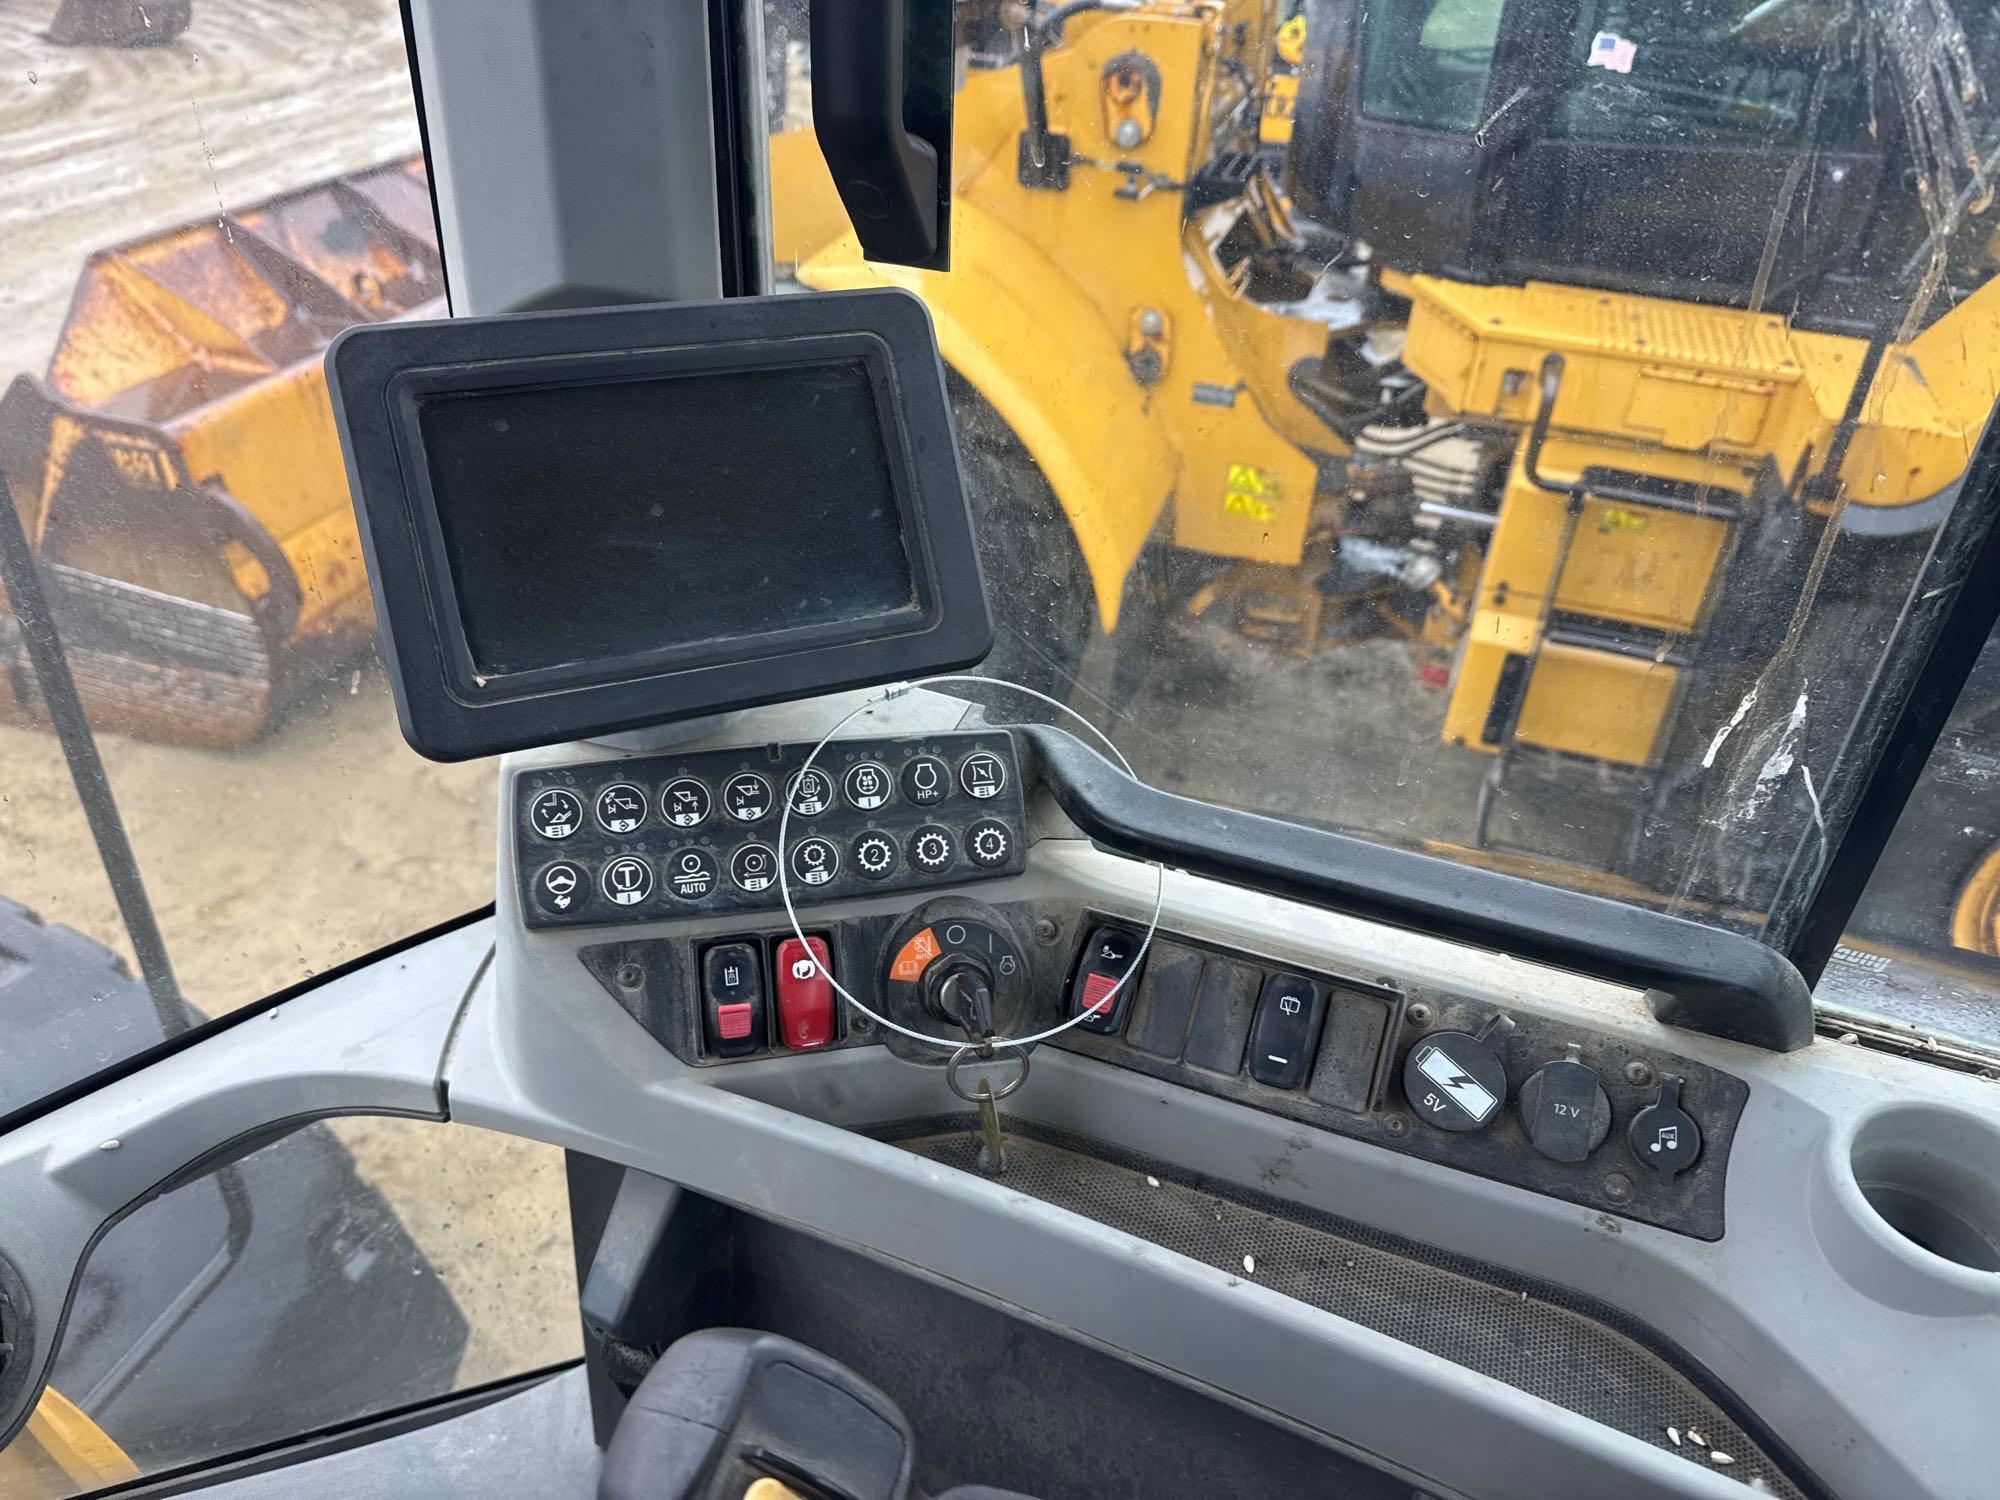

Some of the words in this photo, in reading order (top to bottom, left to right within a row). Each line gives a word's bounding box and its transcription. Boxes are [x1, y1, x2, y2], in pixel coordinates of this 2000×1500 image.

[917, 789, 939, 799] HP+
[929, 842, 938, 855] 3
[986, 837, 994, 850] 4
[812, 851, 818, 859] 1
[870, 849, 880, 862] 2
[618, 866, 636, 887] T
[680, 882, 706, 894] AUTO
[1423, 1092, 1447, 1112] 5V
[1554, 1103, 1567, 1115] 12
[1570, 1107, 1580, 1118] V
